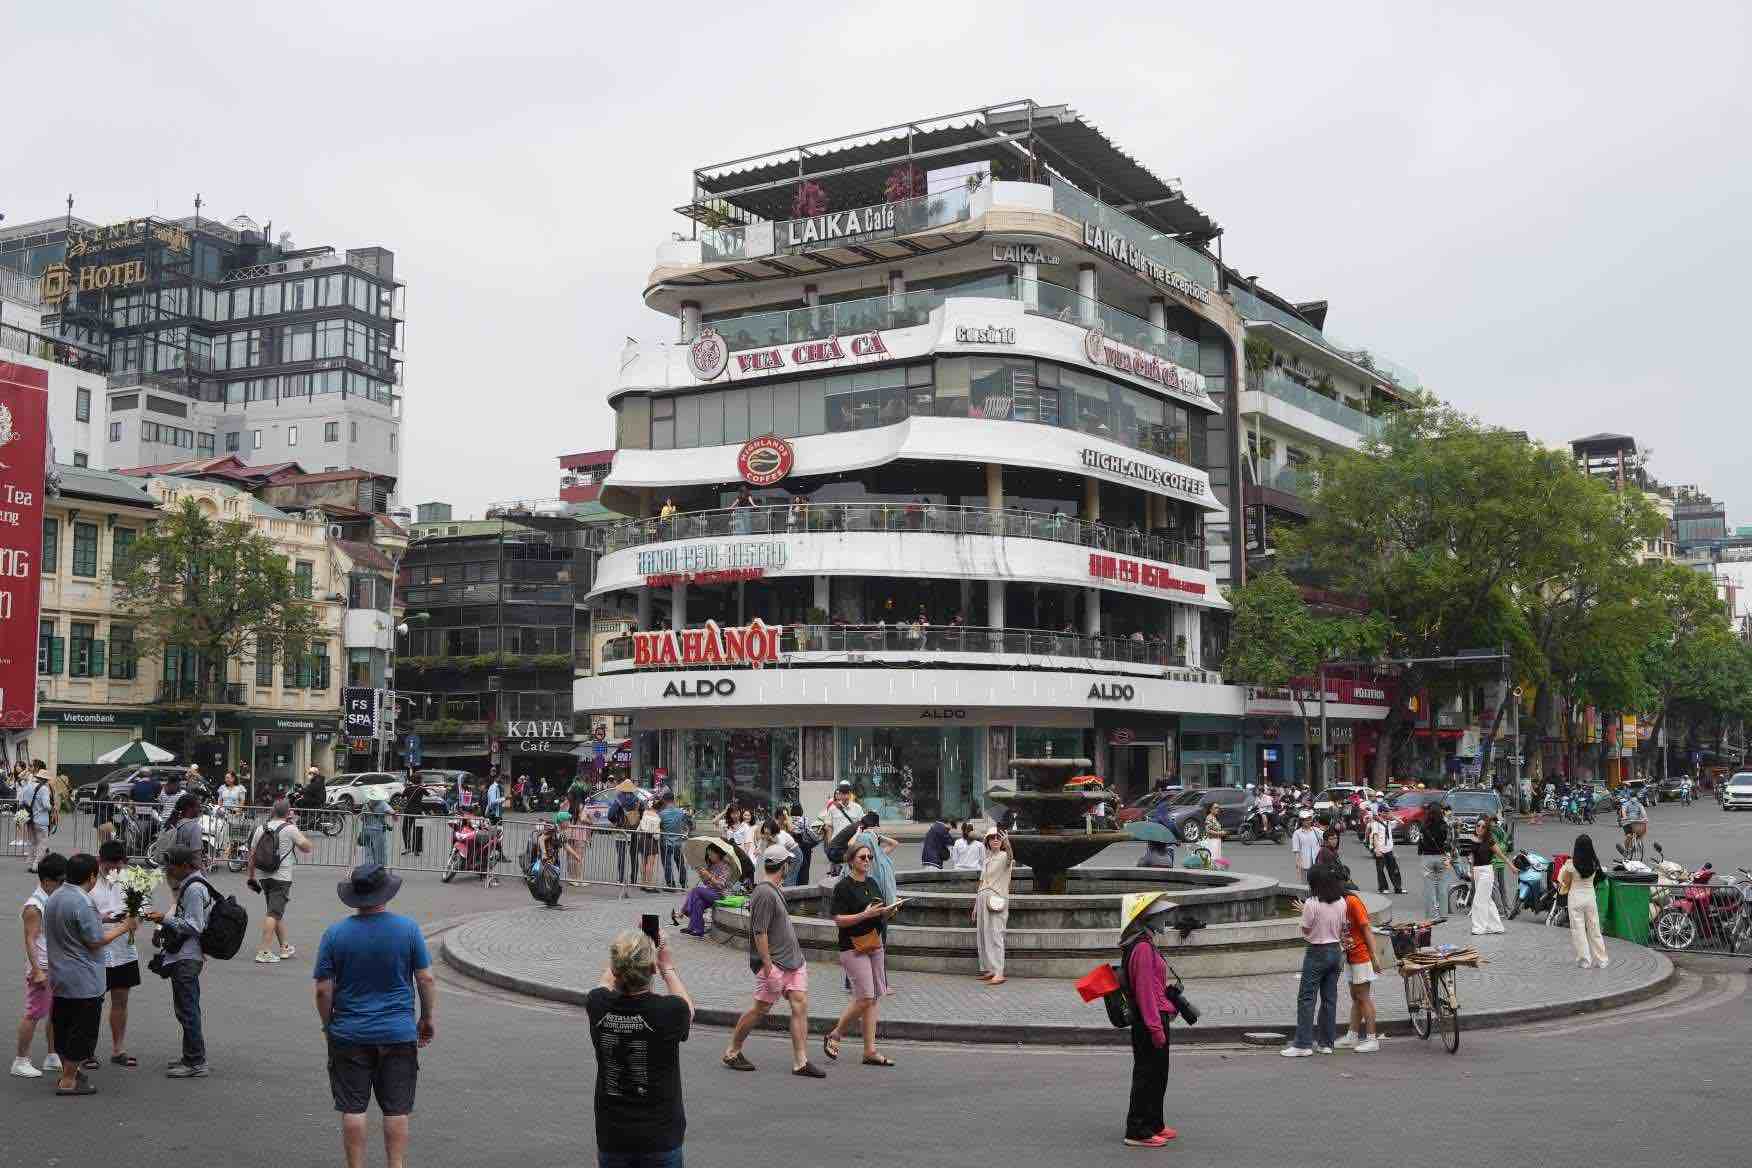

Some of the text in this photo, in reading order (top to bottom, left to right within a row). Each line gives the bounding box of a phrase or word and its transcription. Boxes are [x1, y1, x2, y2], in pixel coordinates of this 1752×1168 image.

[789, 205, 894, 245] LAIKA Café
[1084, 219, 1128, 263] LAIKA
[992, 246, 1045, 264] LAIKA
[80, 261, 147, 290] HOTEL
[737, 349, 784, 371] VUA
[741, 440, 788, 461] HIGHLANDS
[746, 470, 786, 482] COFFEE
[1081, 449, 1205, 495] HIGHLANDS COFFEE
[4, 485, 33, 506] Tea
[633, 631, 679, 667] BIA
[663, 679, 736, 697] ALDO
[1088, 682, 1134, 700] ALDO
[352, 700, 368, 710] FS
[920, 709, 966, 718] ALDO
[64, 712, 115, 722] Vietcombank
[349, 713, 372, 725] SPA
[507, 721, 566, 737] KAFA
[520, 740, 551, 752] Café
